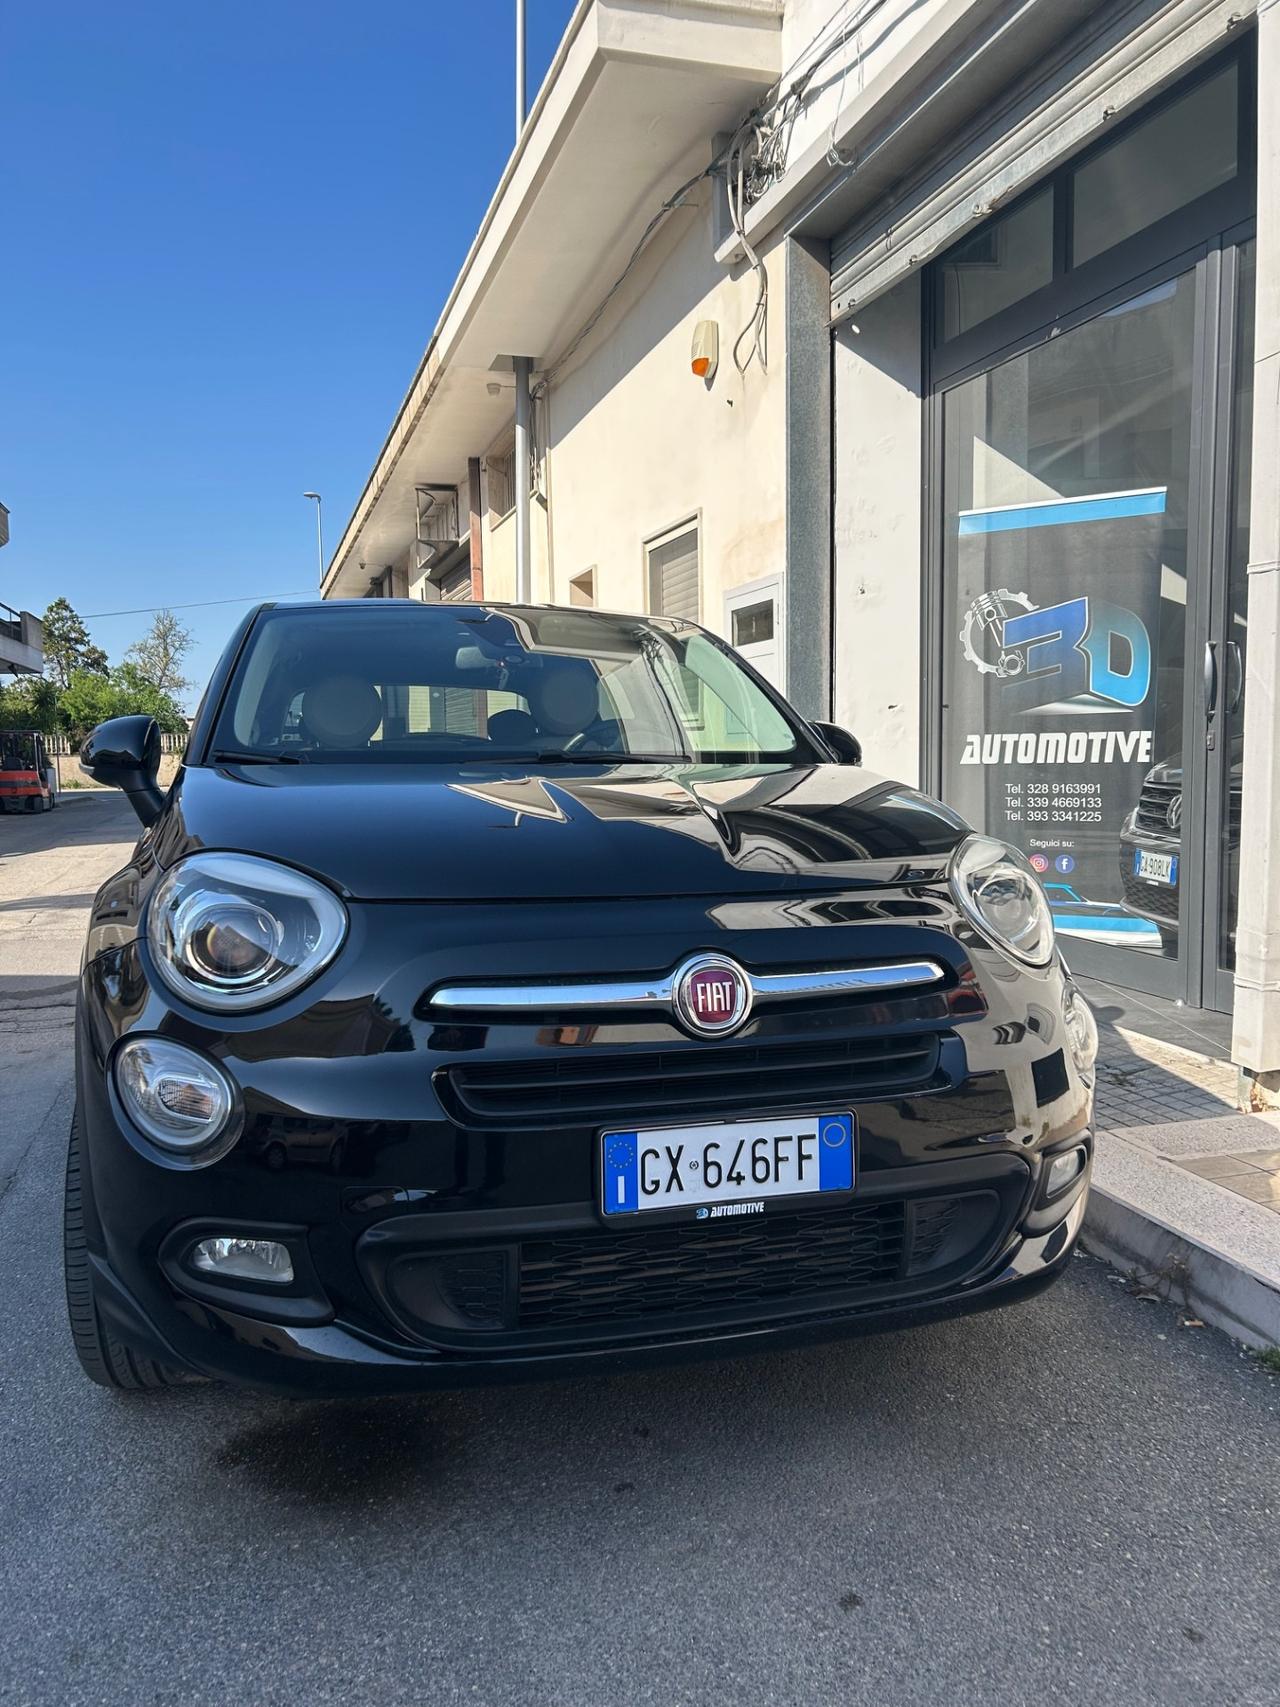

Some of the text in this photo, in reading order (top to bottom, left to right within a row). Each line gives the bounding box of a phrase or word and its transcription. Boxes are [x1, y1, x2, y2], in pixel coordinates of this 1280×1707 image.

[960, 731, 1152, 765] AUTOMOTIVE
[1005, 783, 1101, 794] Tel. 328 9163991
[1005, 797, 1102, 808] Tel. 339 4669133
[1005, 810, 1102, 822] Tel. 393 3341225
[1029, 838, 1060, 848] Seguici
[696, 981, 733, 1013] FIAT
[640, 1133, 817, 1195] GX 646FF
[710, 1201, 765, 1218] AUTOMOTIVE
